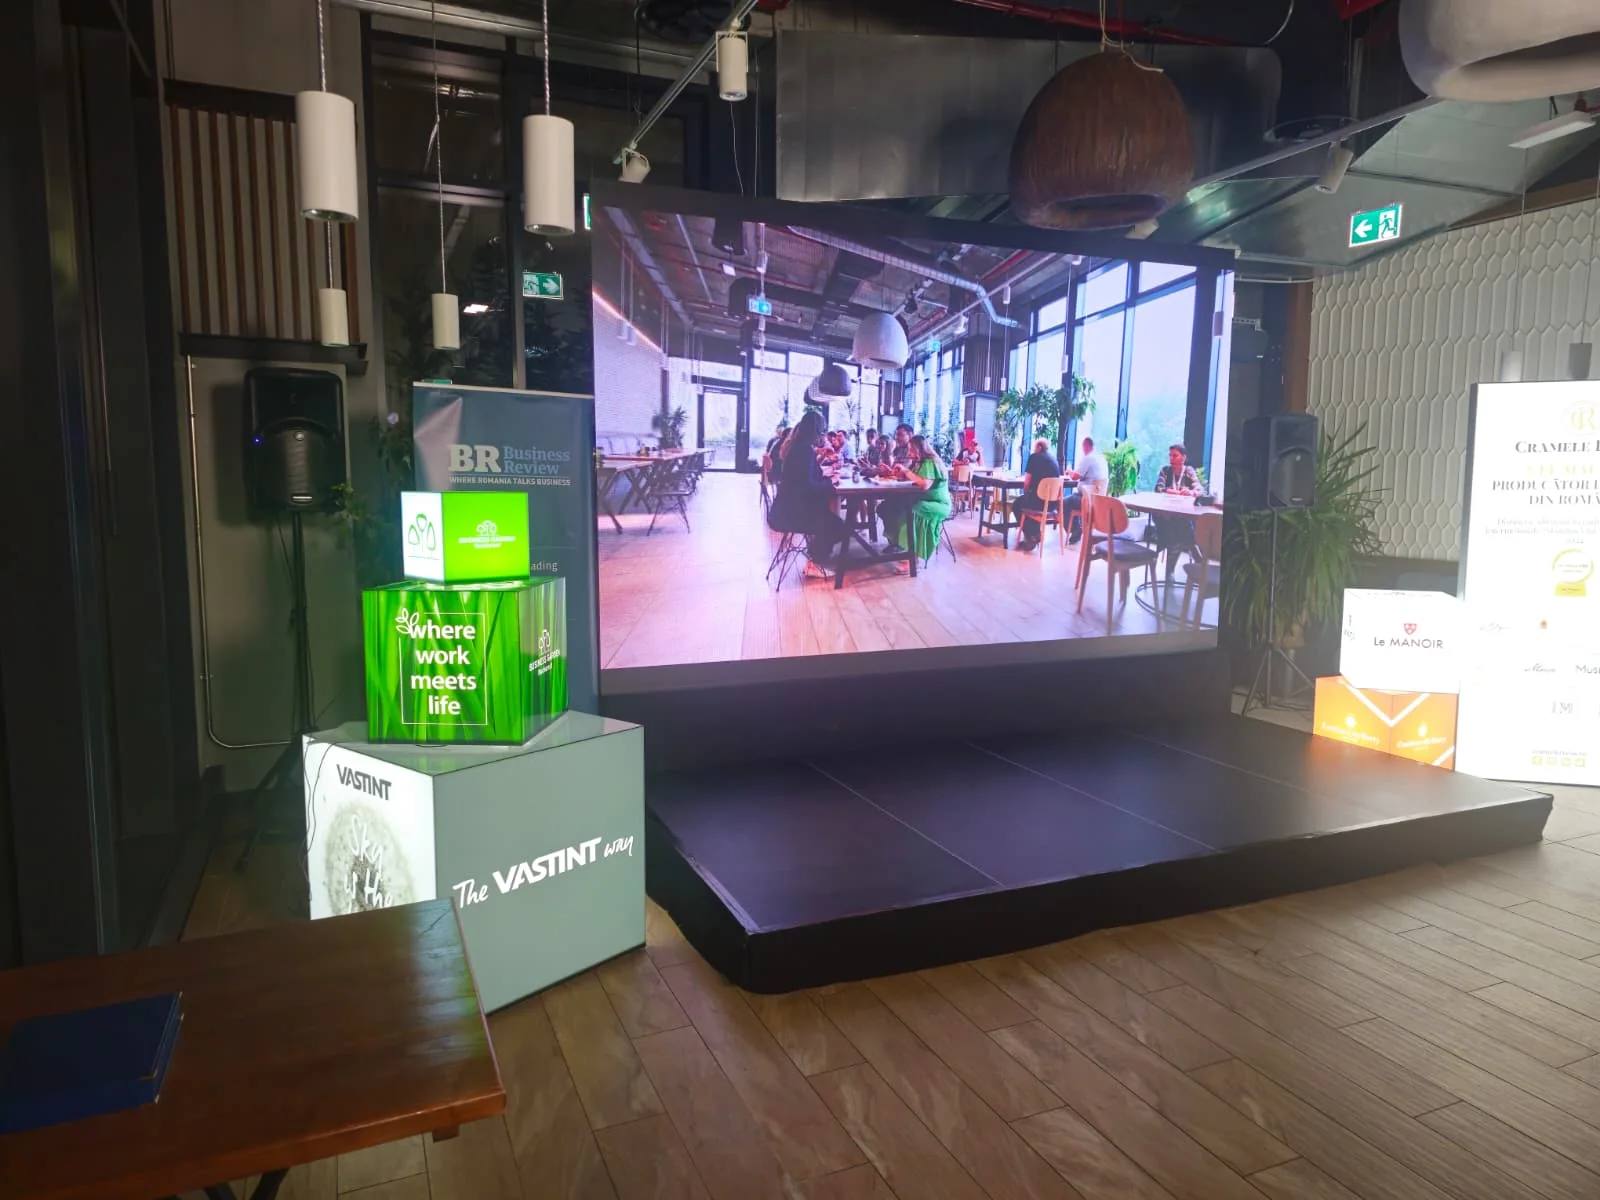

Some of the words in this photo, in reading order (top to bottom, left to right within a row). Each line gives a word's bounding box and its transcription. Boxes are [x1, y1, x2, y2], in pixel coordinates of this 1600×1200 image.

[448, 443, 501, 473] BR
[503, 446, 571, 462] Business
[503, 460, 559, 475] Review
[449, 476, 477, 484] WHERE
[478, 477, 512, 485] ROMANIA
[513, 478, 536, 486] TALKS
[536, 478, 571, 486] BUSINESS
[530, 560, 558, 572] ading
[409, 619, 475, 640] where
[1390, 637, 1444, 649] MANOIR
[416, 645, 471, 665] work
[411, 673, 477, 691] meets
[428, 695, 461, 715] life
[336, 763, 392, 801] VASTINT
[349, 814, 383, 872] Sky
[452, 878, 489, 909] The
[492, 837, 602, 894] VASTINT
[604, 835, 634, 857] way
